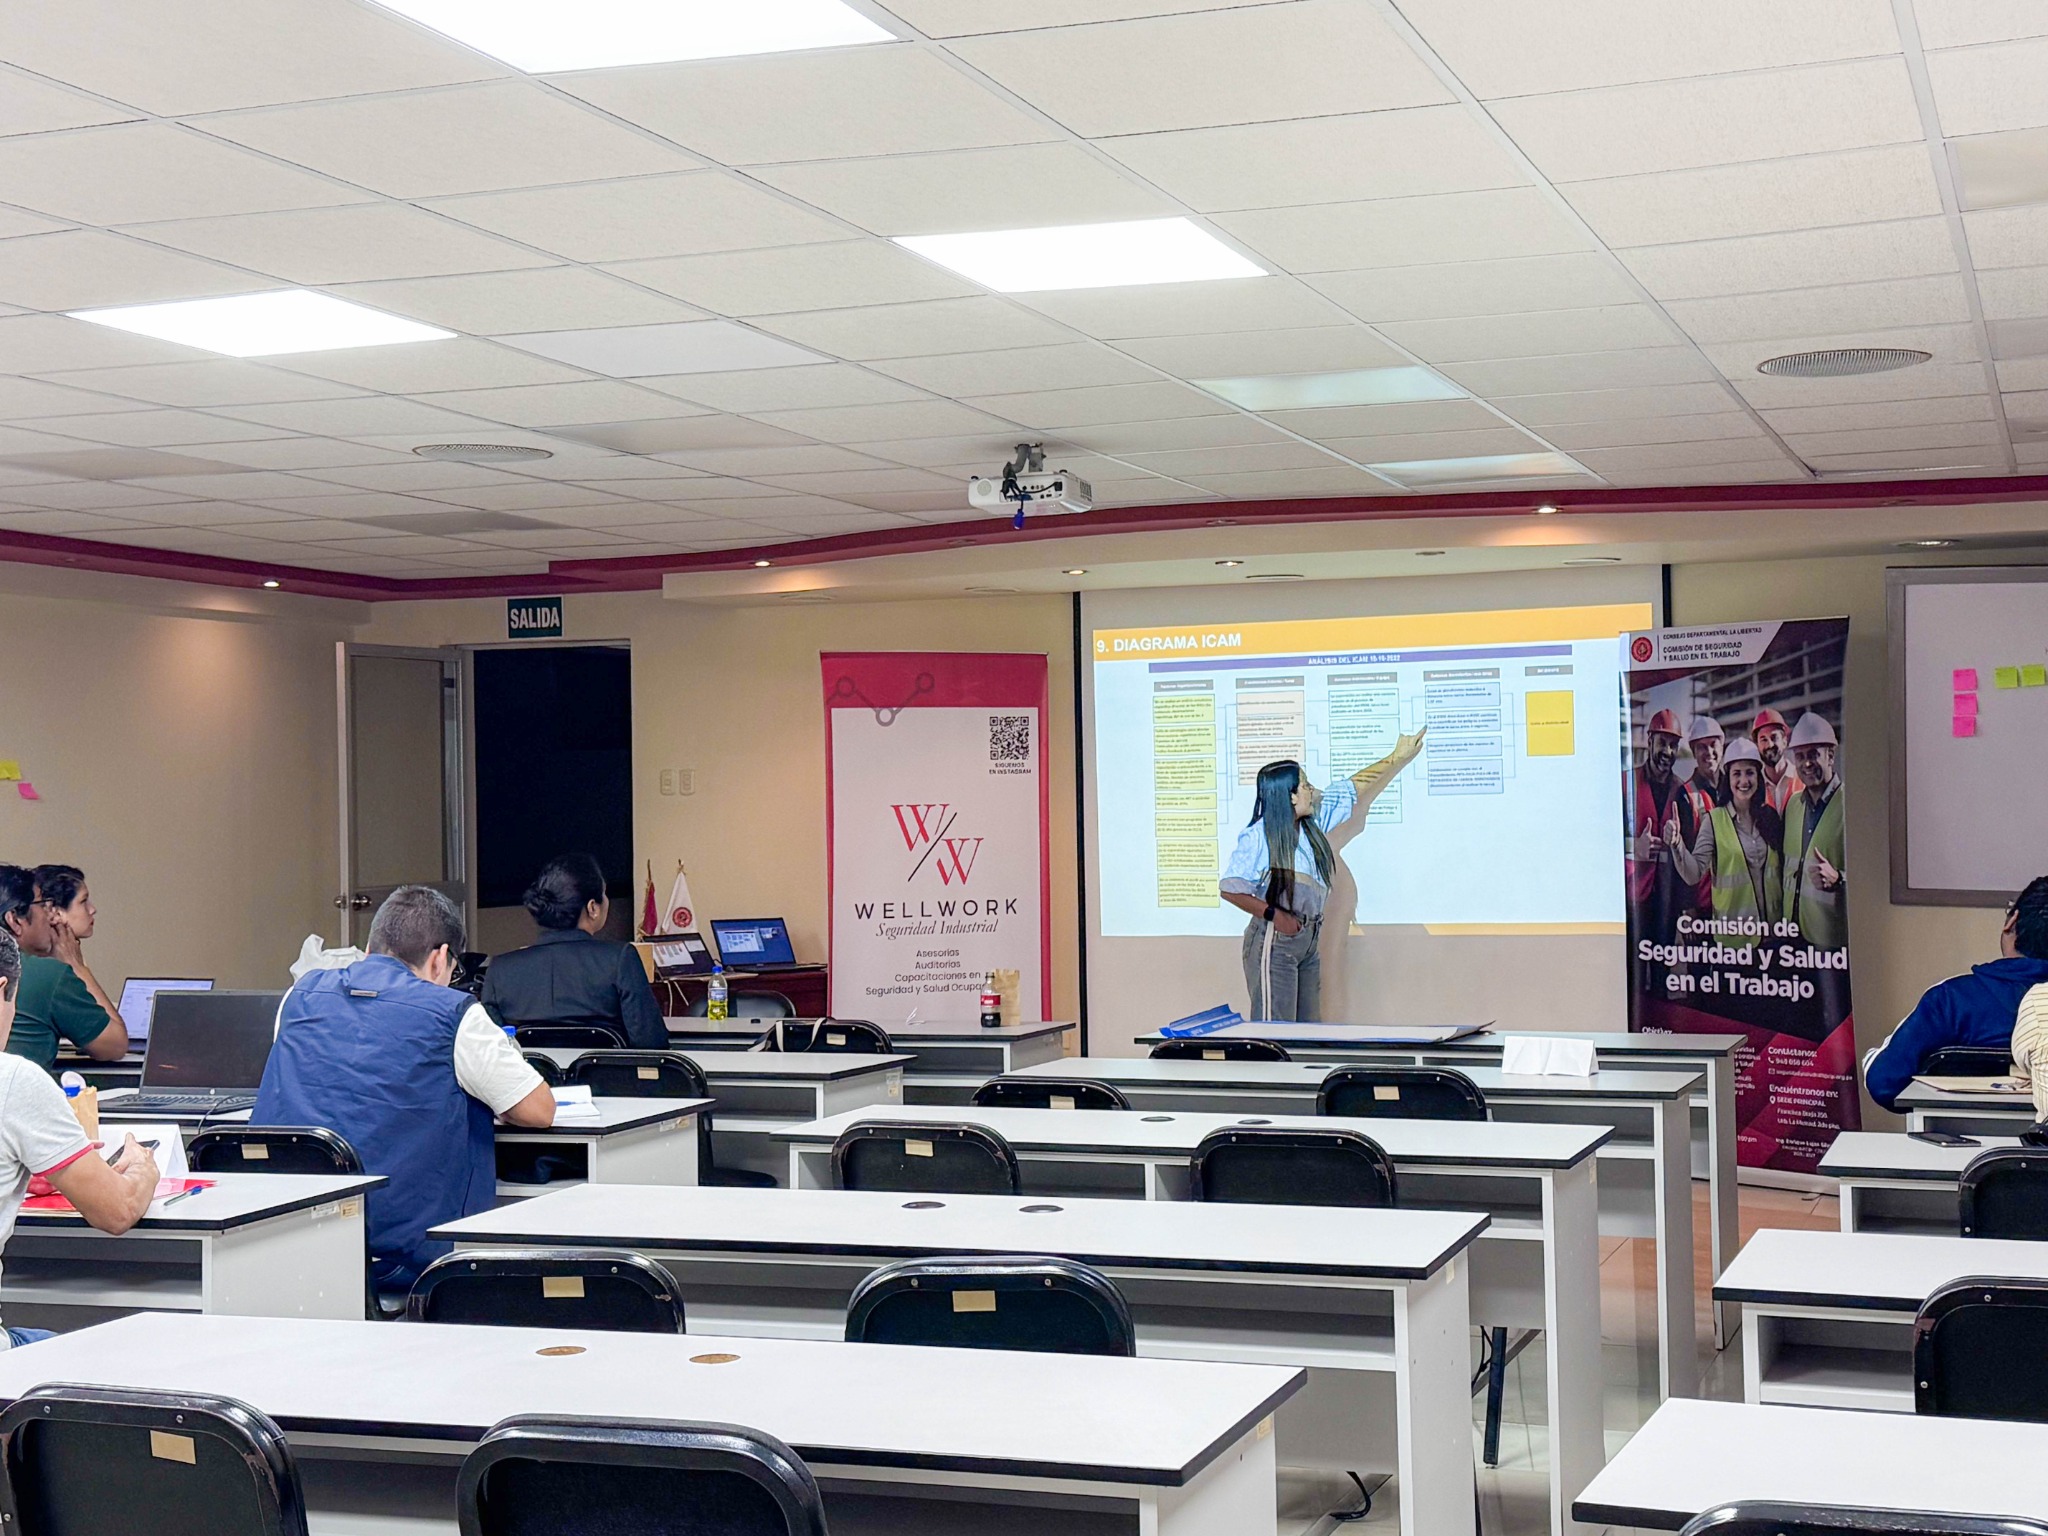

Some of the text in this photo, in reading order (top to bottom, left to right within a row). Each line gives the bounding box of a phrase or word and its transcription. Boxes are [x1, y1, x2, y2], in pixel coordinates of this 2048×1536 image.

[510, 606, 560, 629] SALIDA
[1096, 632, 1241, 653] 9. DIAGRAMA ICAM
[1687, 630, 1728, 638] DEPARTAMENTAL
[1663, 641, 1742, 653] COMISIÓN DE SEGURIDAD
[1668, 653, 1689, 662] SALUD
[1710, 650, 1740, 658] TRABAJO
[855, 898, 1018, 920] WELLWORK
[876, 919, 999, 940] Seguridad Industrial
[1677, 916, 1799, 937] Comisión de
[1638, 940, 1848, 970] Seguridad y Salud
[894, 972, 967, 983] Capacitaciones
[1666, 971, 1815, 1002] en el Trabajo
[865, 985, 914, 998] Seguridad
[915, 986, 920, 996] y
[923, 983, 950, 993] Salud
[1793, 1098, 1826, 1107] PRINCIPAL
